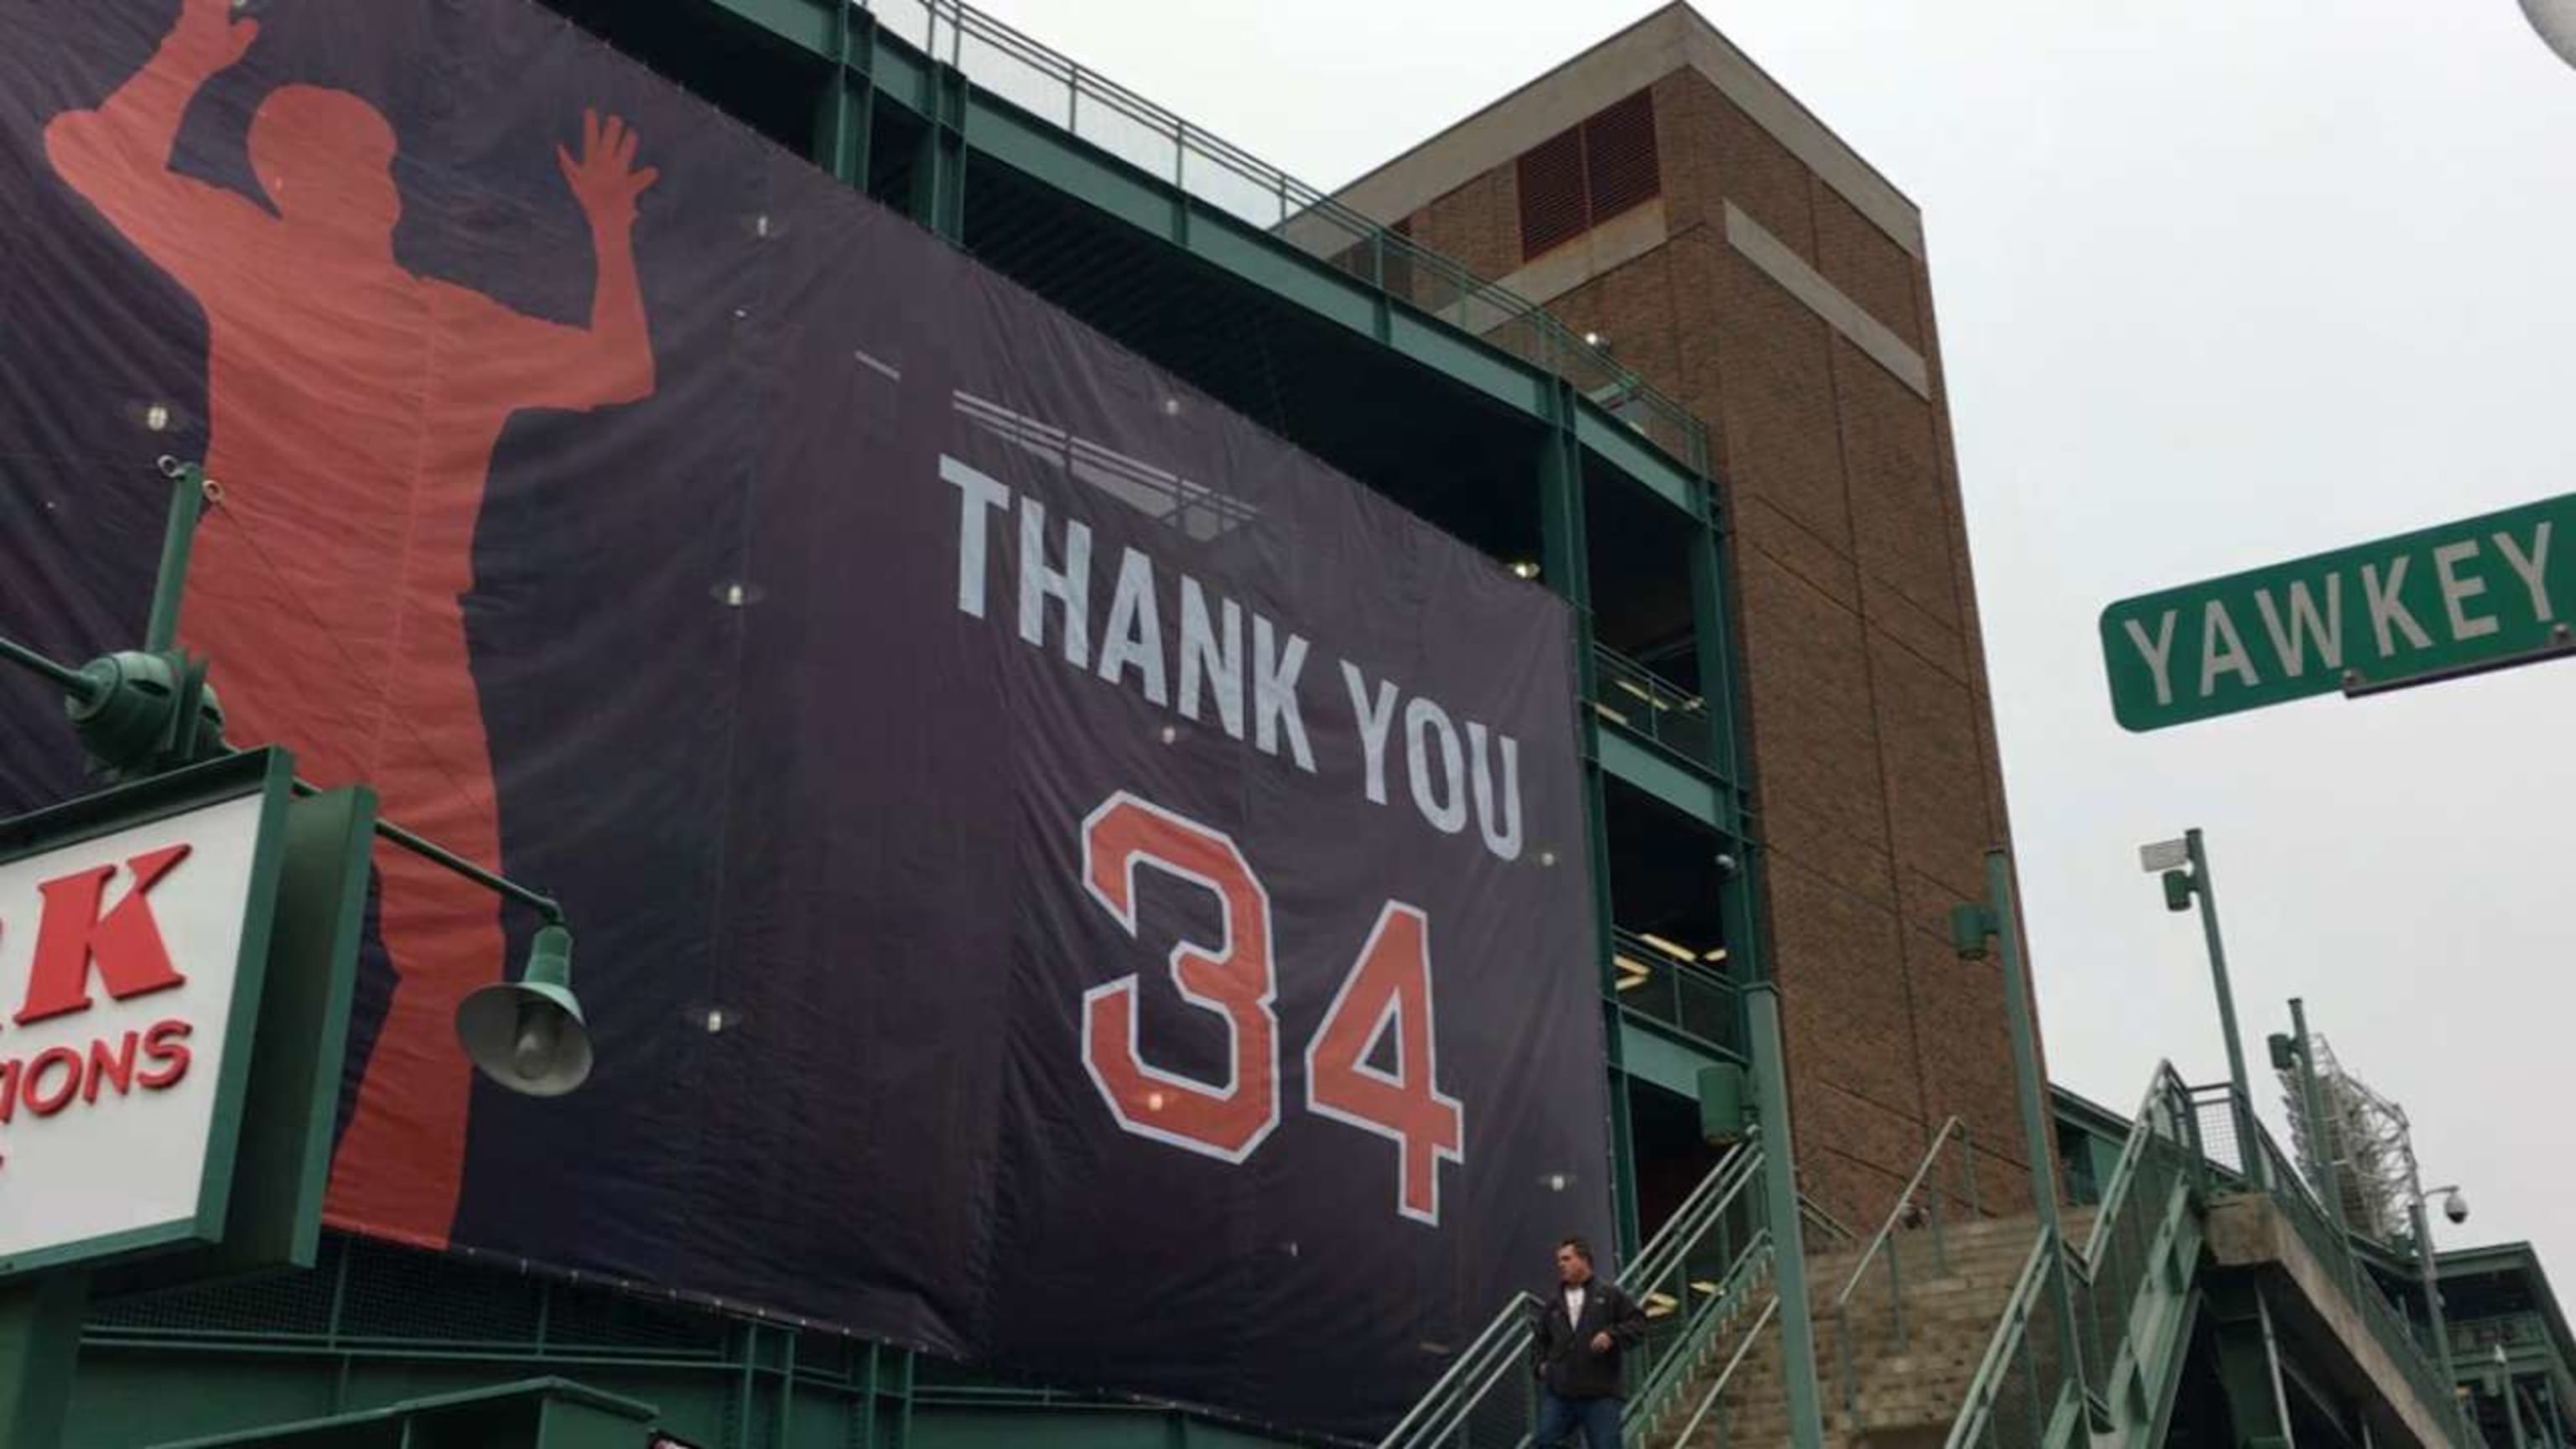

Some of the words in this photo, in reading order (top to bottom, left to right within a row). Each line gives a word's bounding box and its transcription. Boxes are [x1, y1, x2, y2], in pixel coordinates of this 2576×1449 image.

[939, 452, 1317, 773] THANK
[1340, 659, 1522, 861] YOU
[2123, 522, 2553, 706] YAWKEY
[0, 844, 192, 1029] K
[1081, 789, 1463, 1227] 34
[0, 1019, 192, 1124] IONS
